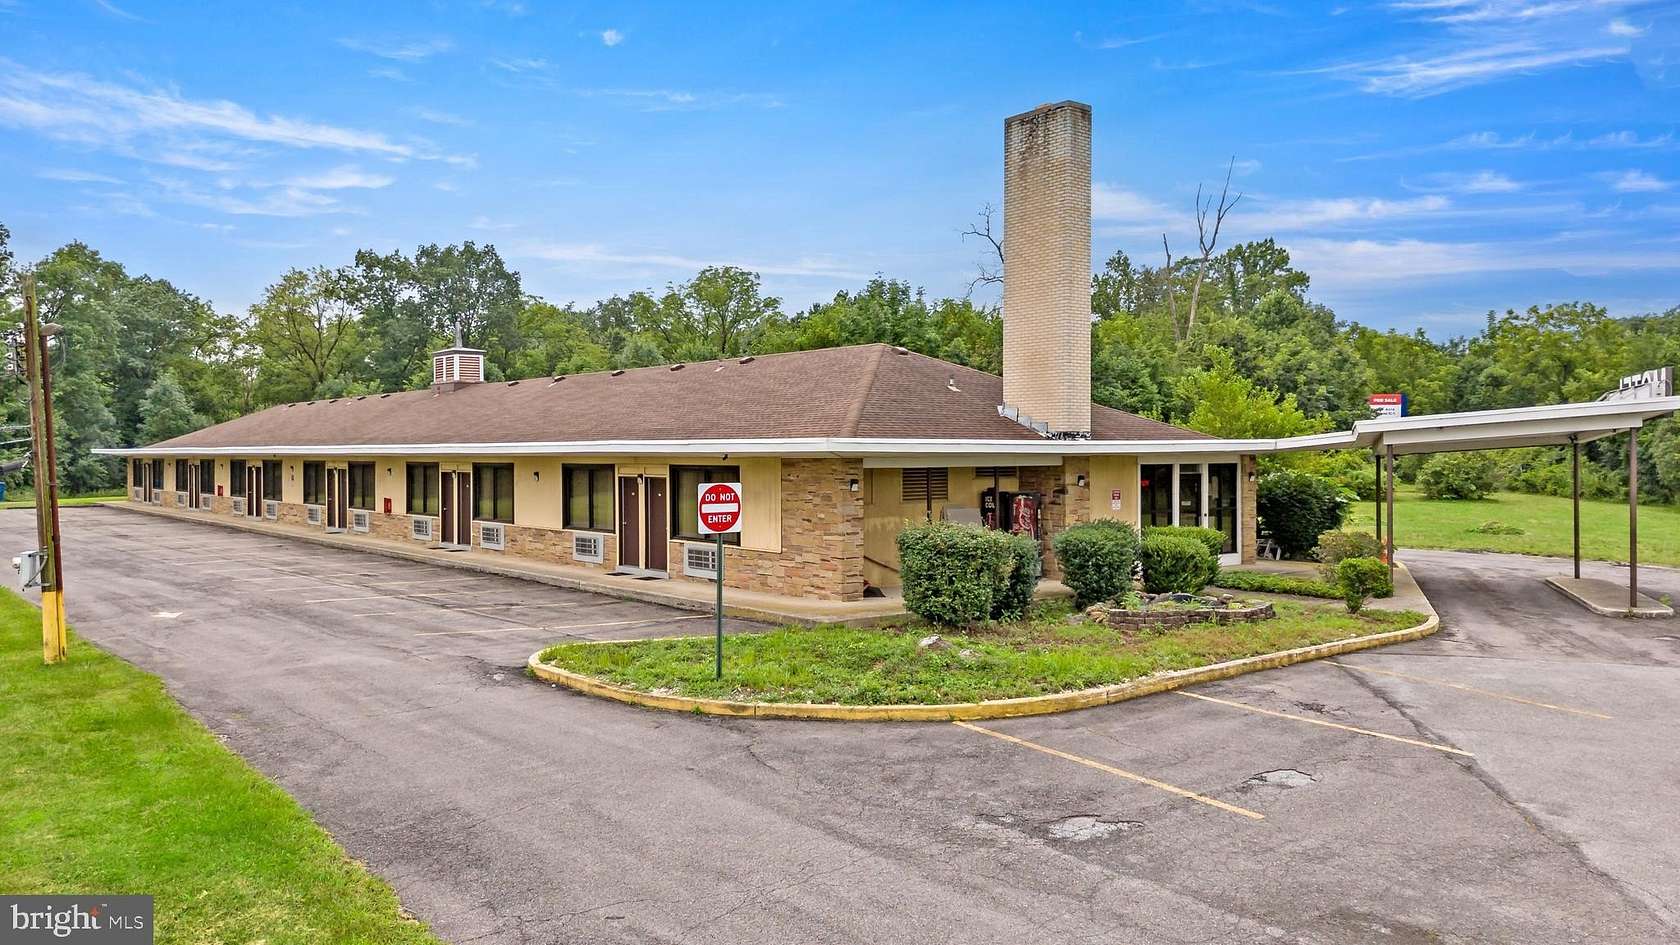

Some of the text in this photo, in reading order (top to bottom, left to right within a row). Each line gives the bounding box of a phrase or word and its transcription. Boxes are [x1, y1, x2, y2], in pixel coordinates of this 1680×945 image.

[705, 493, 736, 502] DO NOT
[708, 514, 732, 523] ENTER
